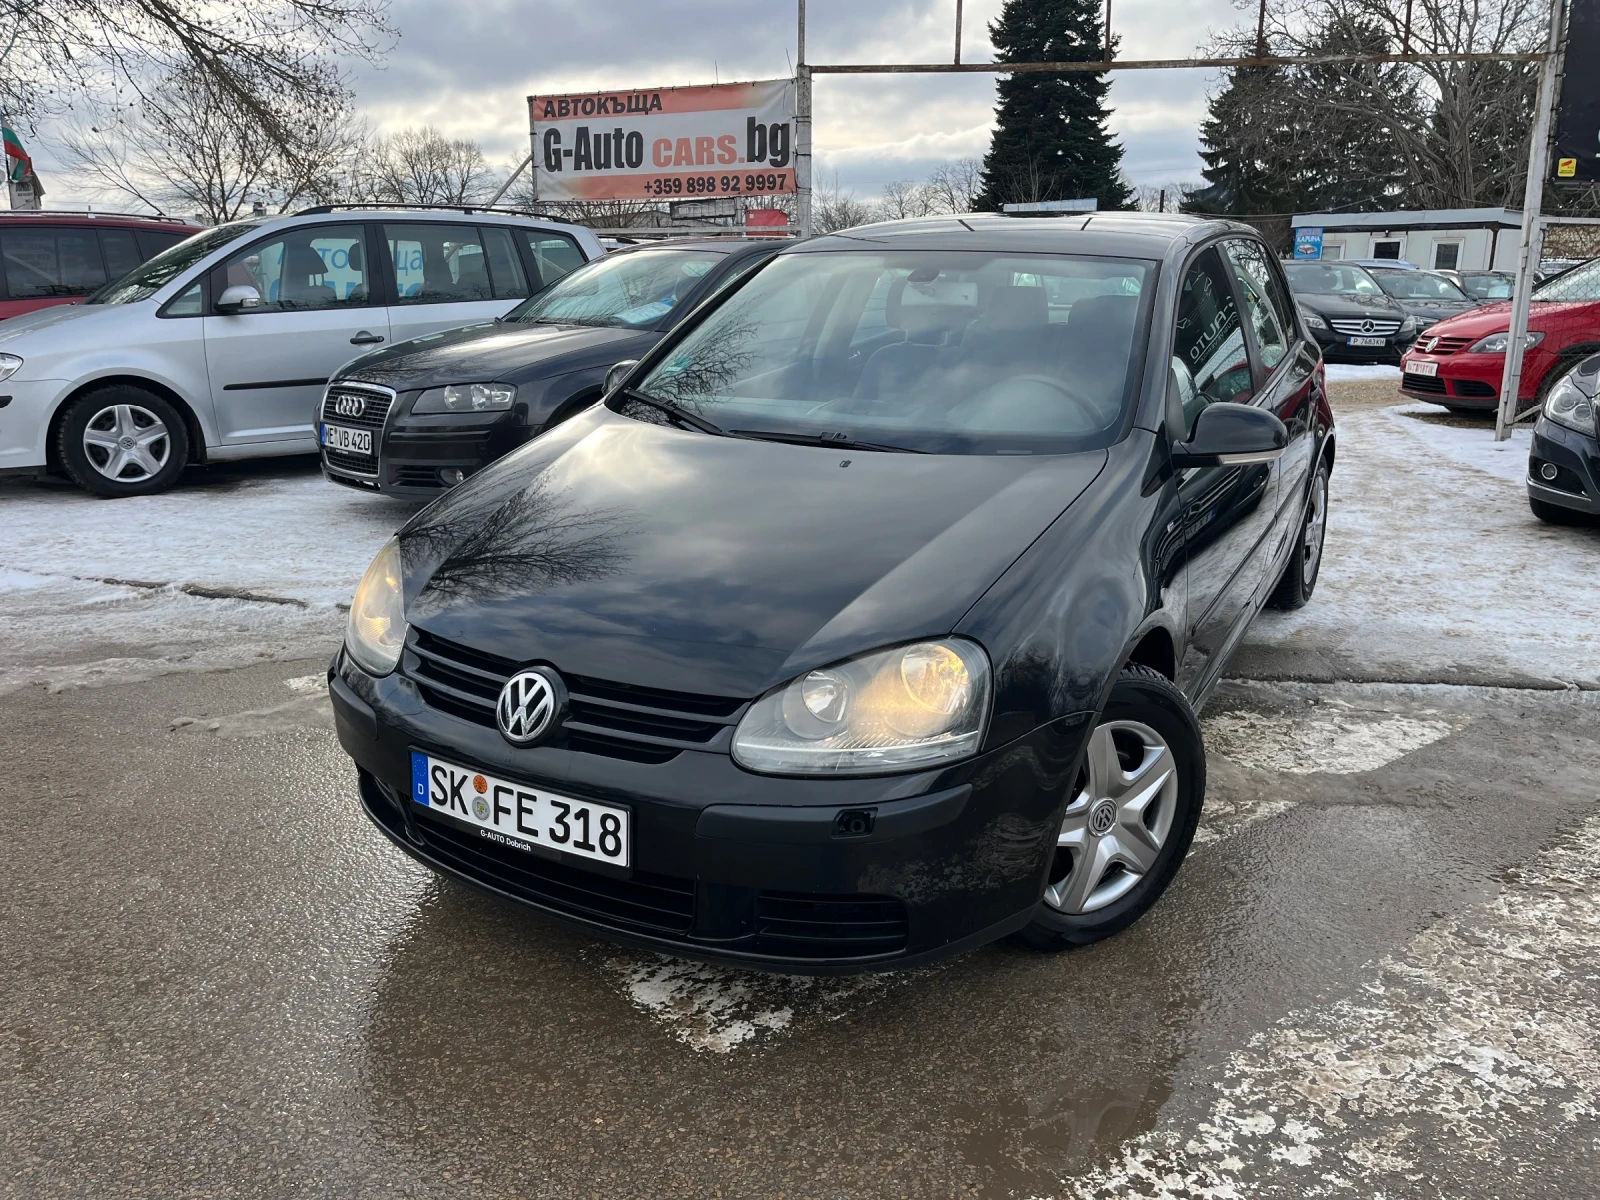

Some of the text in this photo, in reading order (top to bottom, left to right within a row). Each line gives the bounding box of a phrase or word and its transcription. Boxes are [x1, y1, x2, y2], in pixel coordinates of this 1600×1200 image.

[543, 93, 663, 118] АВТОКЪЩА
[543, 126, 644, 172] G-Auto
[644, 174, 787, 195] +359 898 92 9997
[339, 429, 350, 447] VB
[351, 432, 370, 451] 420
[417, 783, 424, 795] D
[430, 765, 622, 857] SK FE 318
[480, 829, 532, 851] G-AUTO Dobrich
